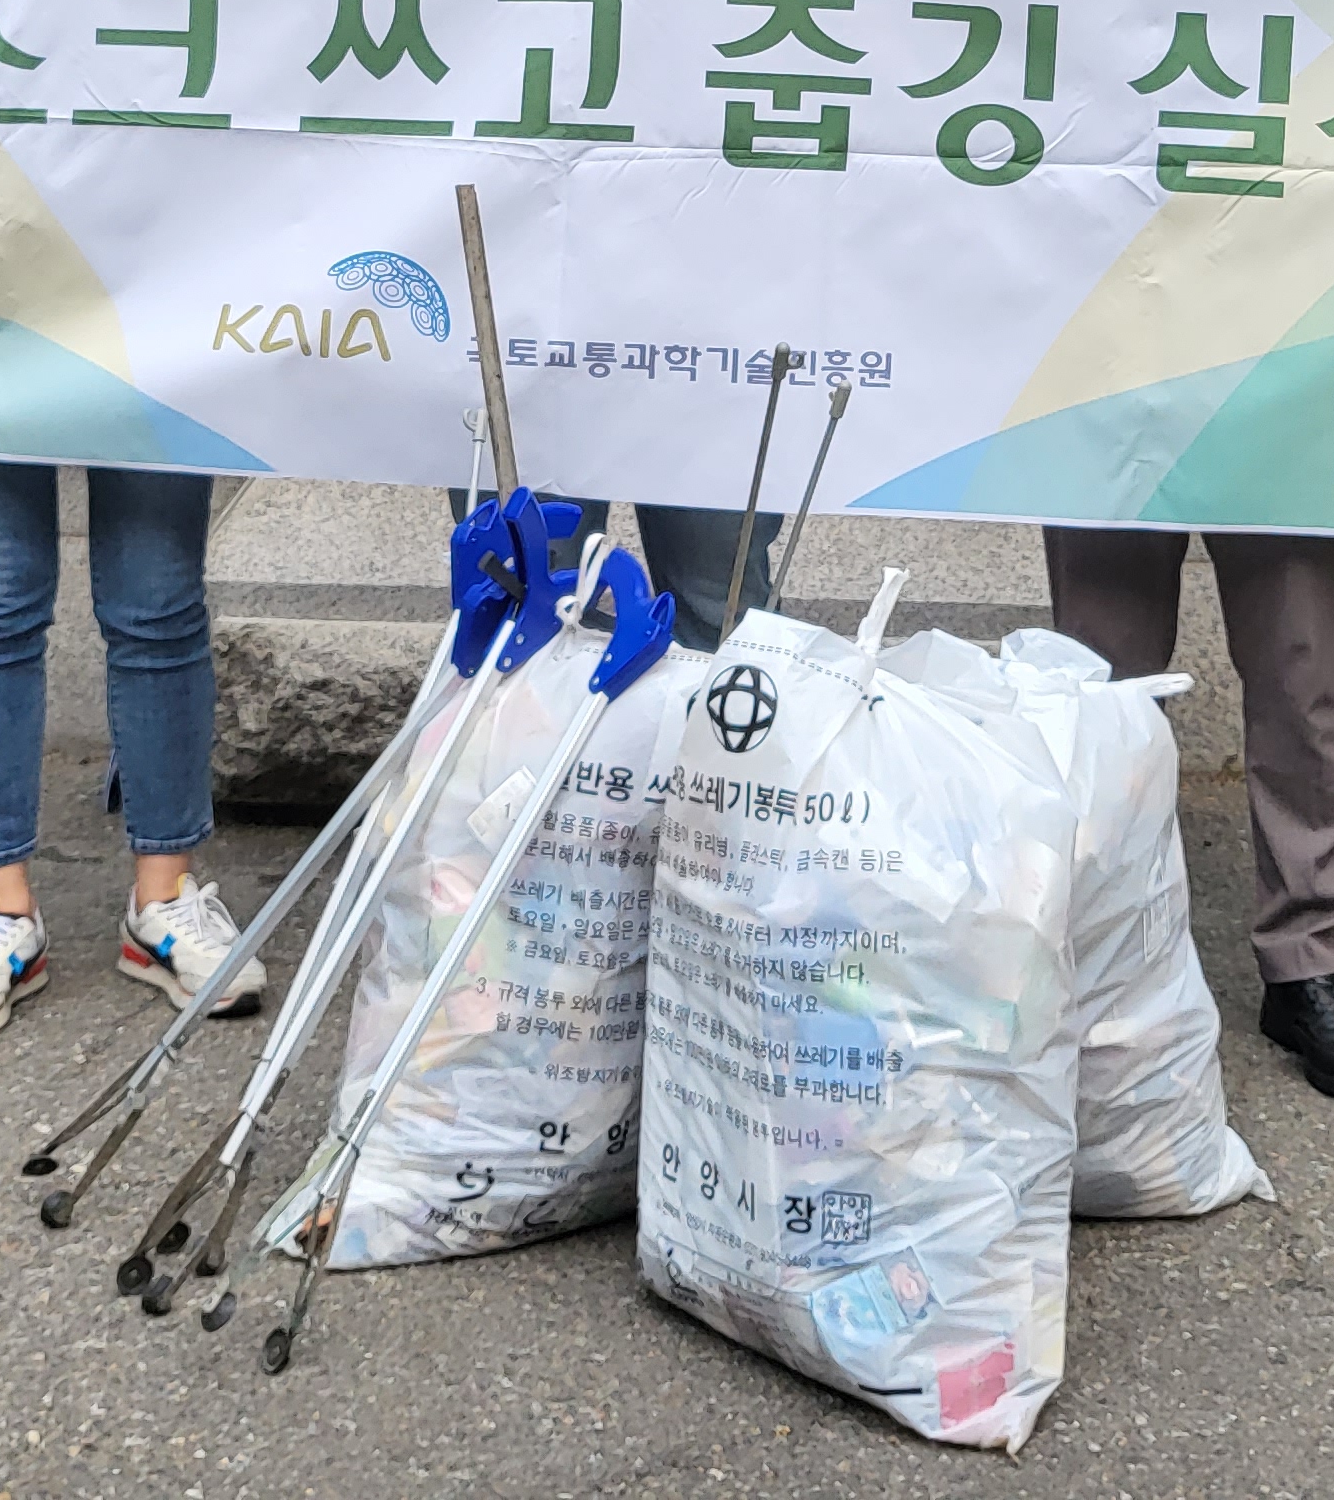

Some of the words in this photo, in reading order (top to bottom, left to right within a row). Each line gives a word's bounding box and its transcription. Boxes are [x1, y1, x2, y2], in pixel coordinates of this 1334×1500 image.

[213, 303, 391, 362] KAIA
[688, 770, 799, 826] 쓰레기봉투
[509, 878, 563, 905] 쓰레기
[790, 958, 870, 985] 않습니다.
[498, 980, 530, 1006] 규격
[534, 986, 566, 1011] 봉투
[771, 991, 825, 1015] 마세요.
[794, 1044, 863, 1071] 쓰레기를
[793, 1076, 888, 1105] 부과합니다.
